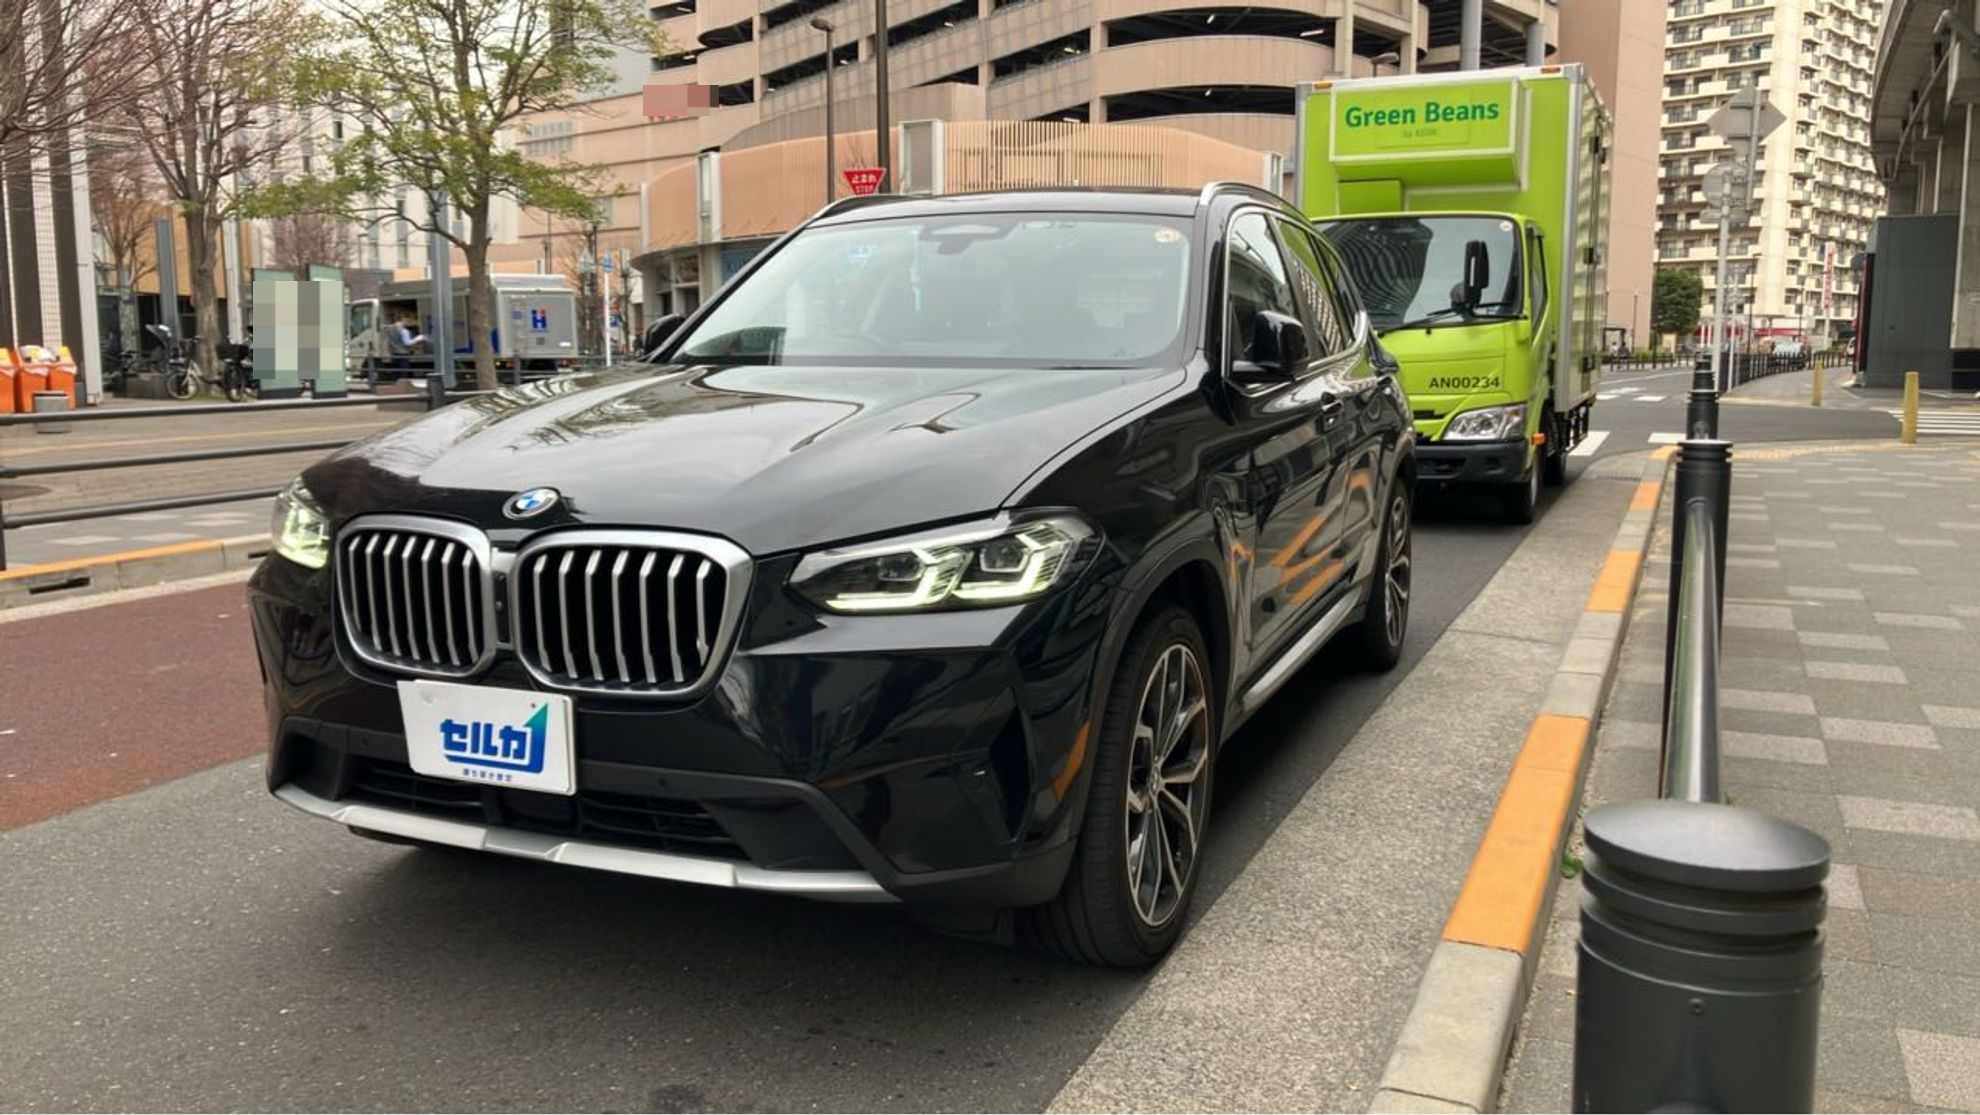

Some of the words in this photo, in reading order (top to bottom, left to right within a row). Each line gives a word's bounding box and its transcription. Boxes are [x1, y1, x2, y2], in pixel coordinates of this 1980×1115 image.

[1345, 106, 1416, 127] Green
[1425, 101, 1499, 123] Beans
[1428, 376, 1500, 389] AN00234
[440, 718, 527, 760] セルカ
